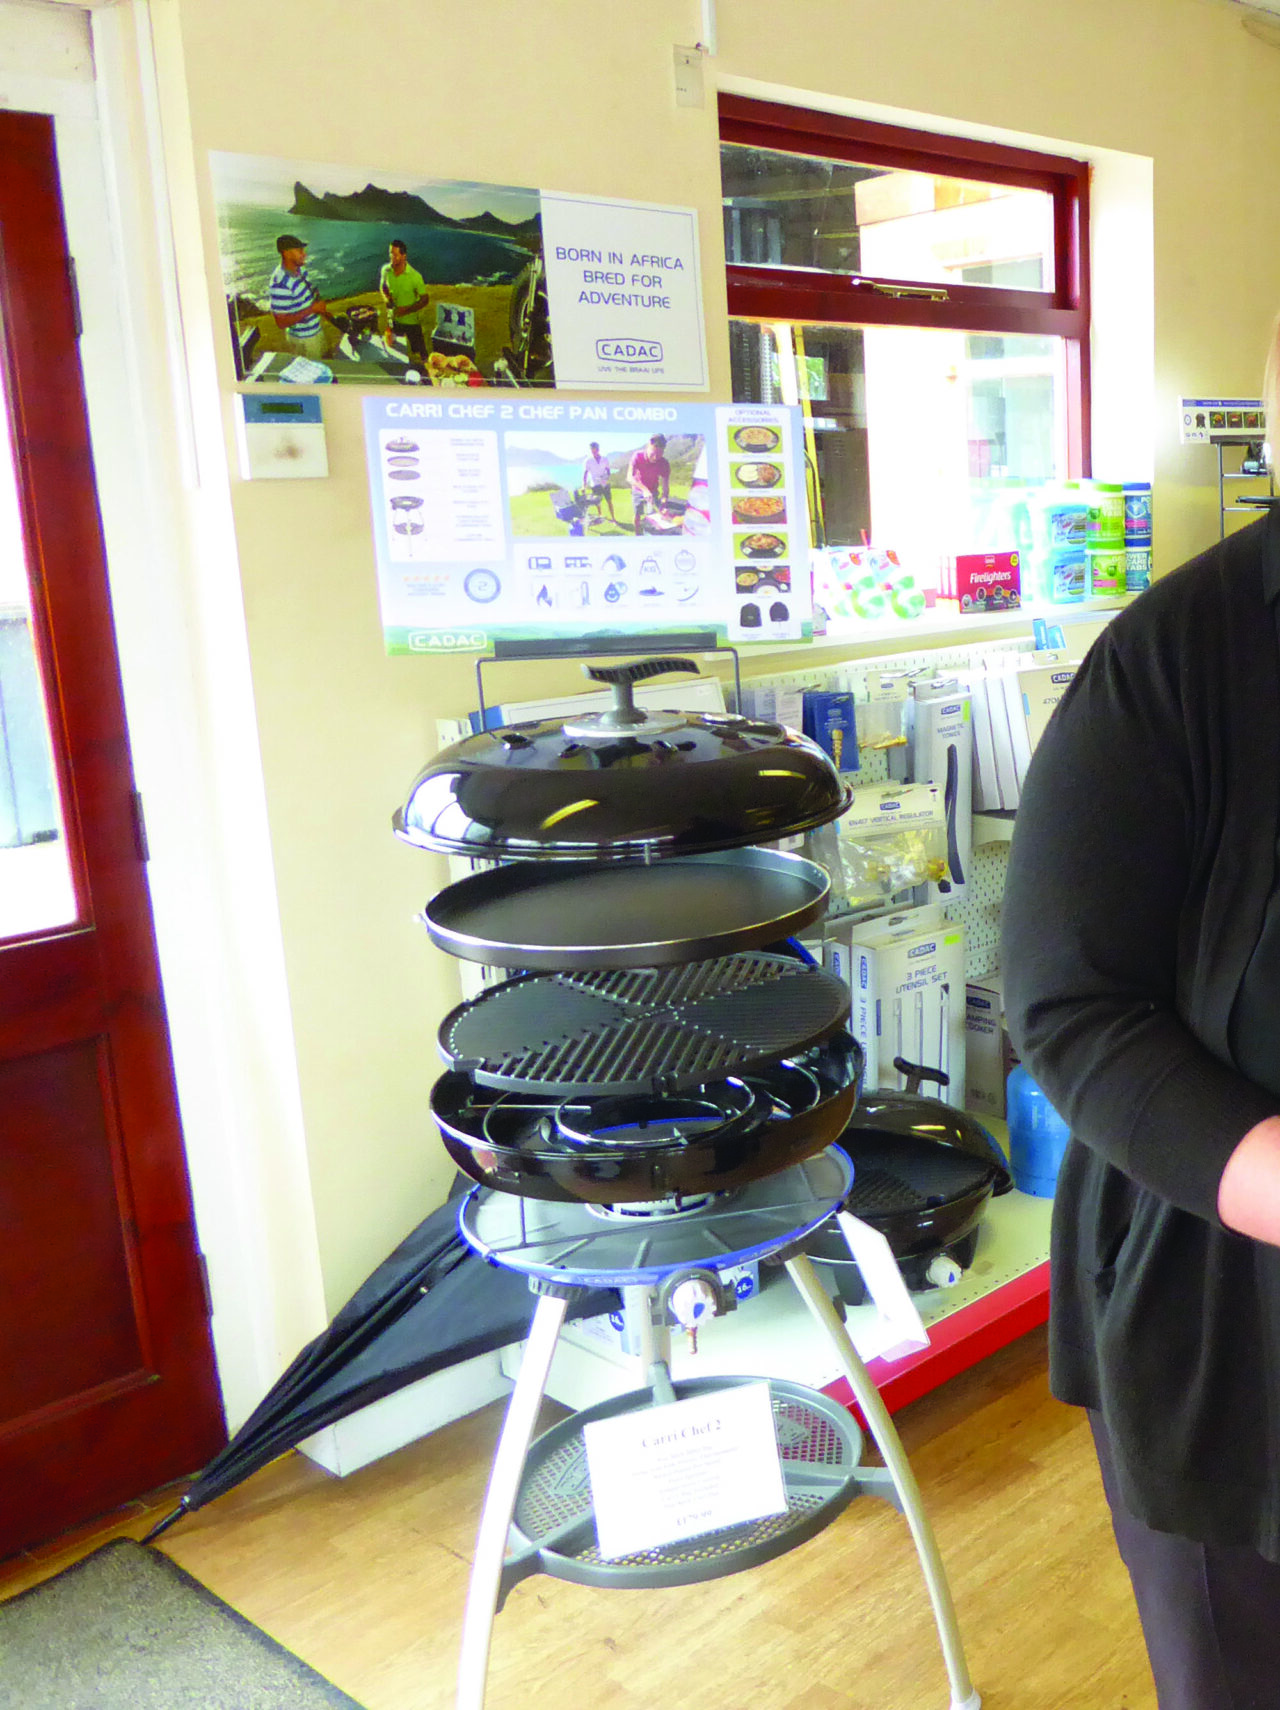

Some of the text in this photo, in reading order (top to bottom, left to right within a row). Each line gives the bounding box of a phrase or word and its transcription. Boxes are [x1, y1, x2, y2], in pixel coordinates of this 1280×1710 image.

[556, 247, 684, 270] BORN IN AFRICA
[583, 270, 662, 288] BRED FOR
[578, 291, 671, 309] ADVENTURE
[601, 344, 659, 358] CADAC
[385, 402, 678, 421] CARRI CHEF 2 CHEF PAN COMBO
[969, 571, 1012, 585] Firelighters
[414, 634, 482, 647] CADAC
[909, 943, 936, 958] CADAC
[906, 965, 936, 981] 3 PIECE
[932, 971, 948, 983] SET
[966, 1014, 997, 1027] AMPING
[642, 1419, 721, 1448] Carri Chef 2
